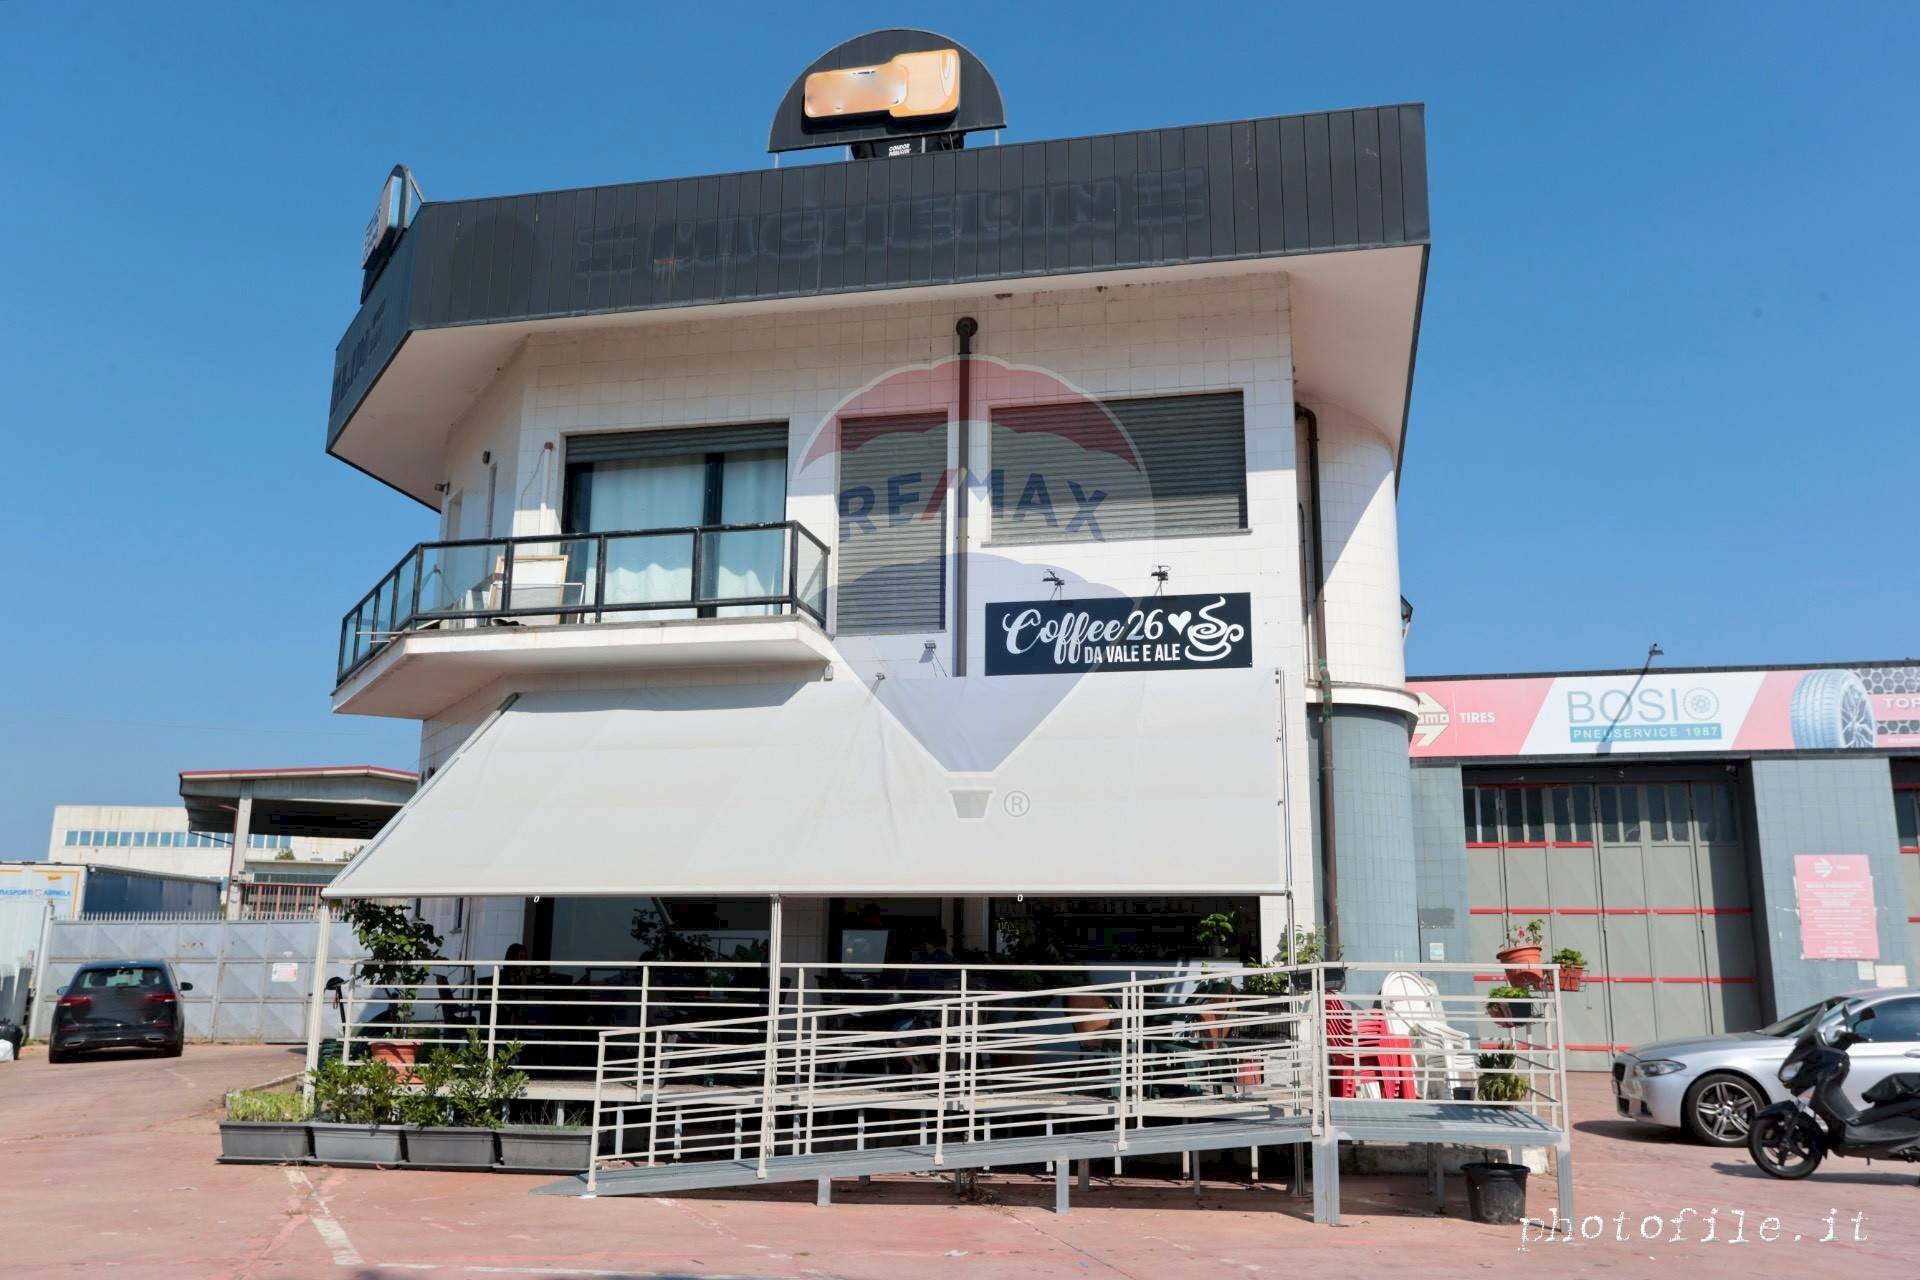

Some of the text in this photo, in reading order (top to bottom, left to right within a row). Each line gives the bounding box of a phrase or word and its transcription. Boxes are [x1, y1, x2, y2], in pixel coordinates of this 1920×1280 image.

[1002, 609, 1164, 665] Coffee 26
[1084, 643, 1181, 664] DA VALE E ALE
[1459, 712, 1496, 723] TIRES
[1573, 727, 1718, 739] PNEUSERVICE 1987
